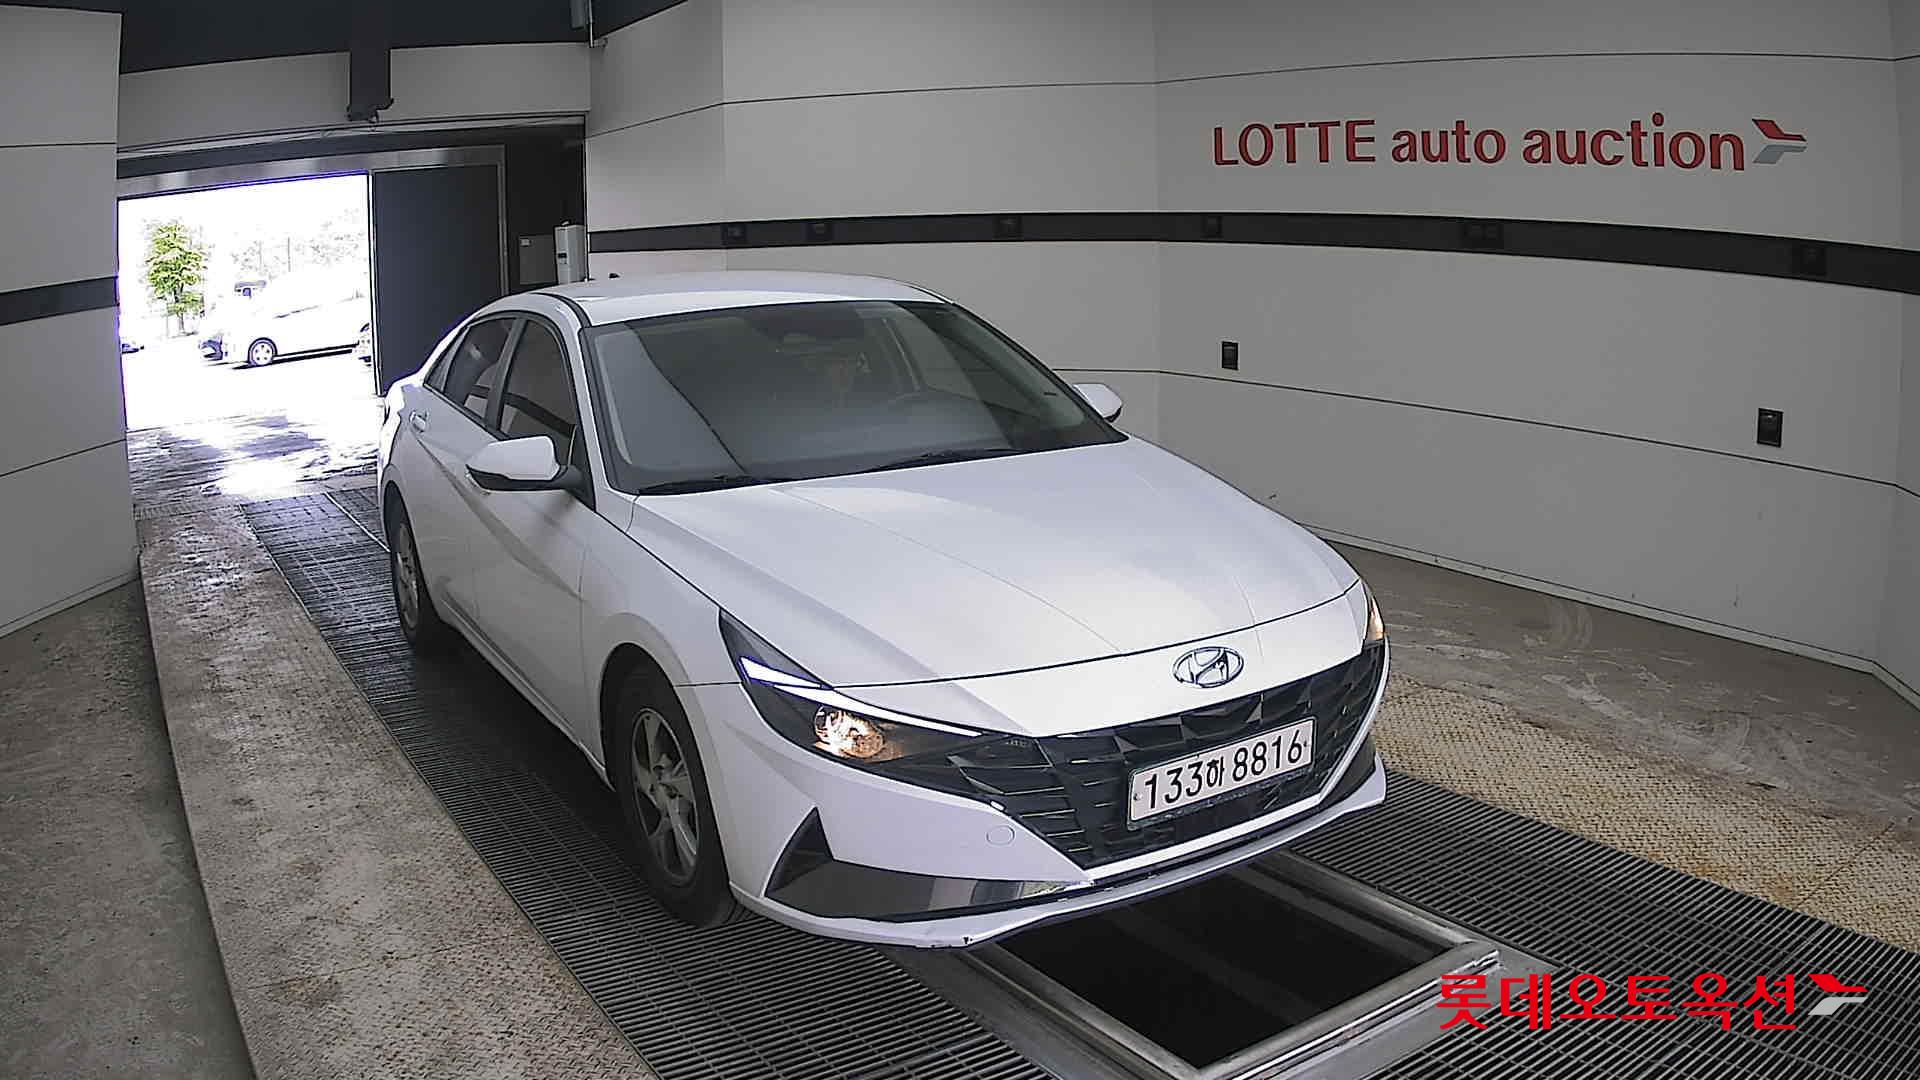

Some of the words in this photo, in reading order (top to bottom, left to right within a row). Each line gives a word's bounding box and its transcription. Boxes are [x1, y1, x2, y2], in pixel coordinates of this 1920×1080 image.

[1214, 119, 1375, 166] LOTTE
[1391, 119, 1506, 165] auto
[1523, 112, 1745, 171] auction
